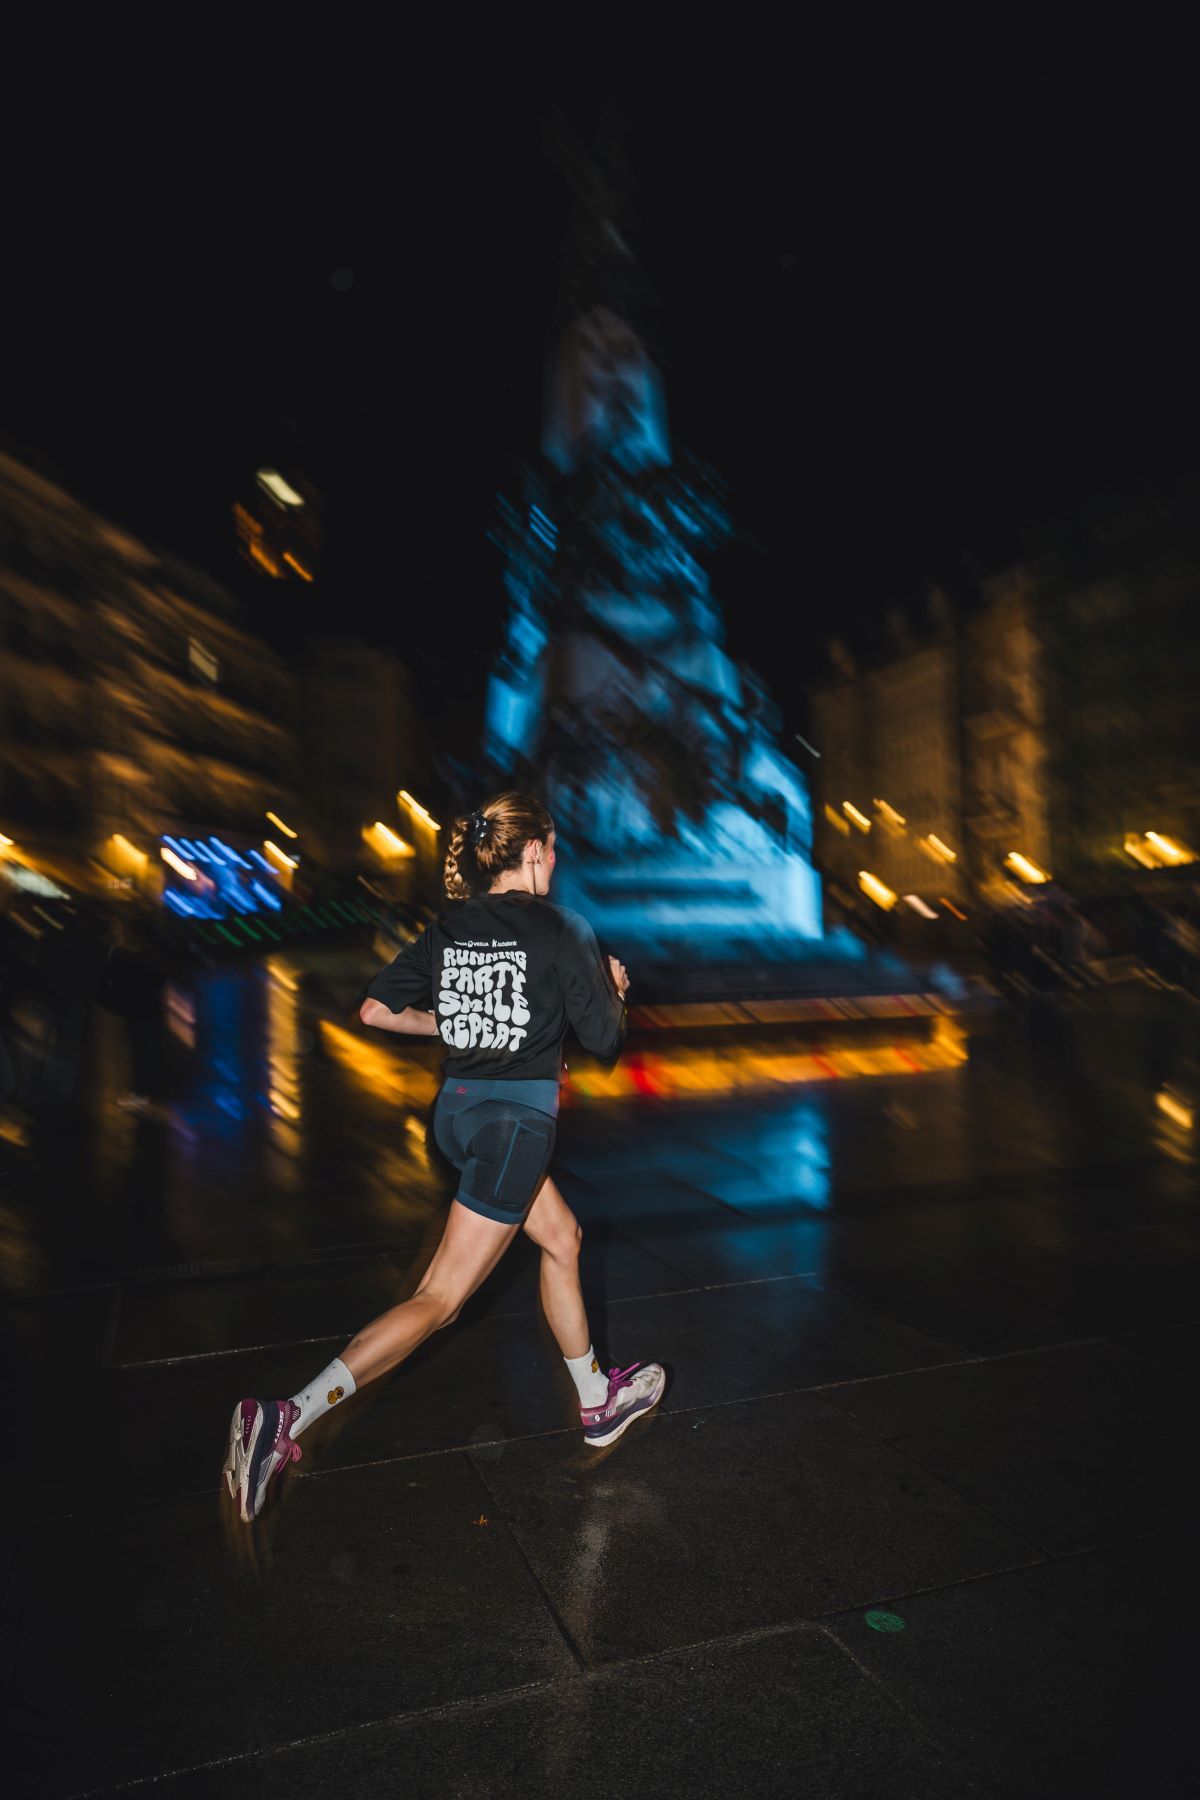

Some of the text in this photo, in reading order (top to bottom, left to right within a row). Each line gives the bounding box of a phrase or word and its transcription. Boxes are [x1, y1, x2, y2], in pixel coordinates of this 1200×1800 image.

[443, 947, 527, 971] RUNNING
[440, 961, 526, 995] PARTY
[438, 988, 531, 1026] SMILE
[440, 1012, 528, 1052] REPEAT
